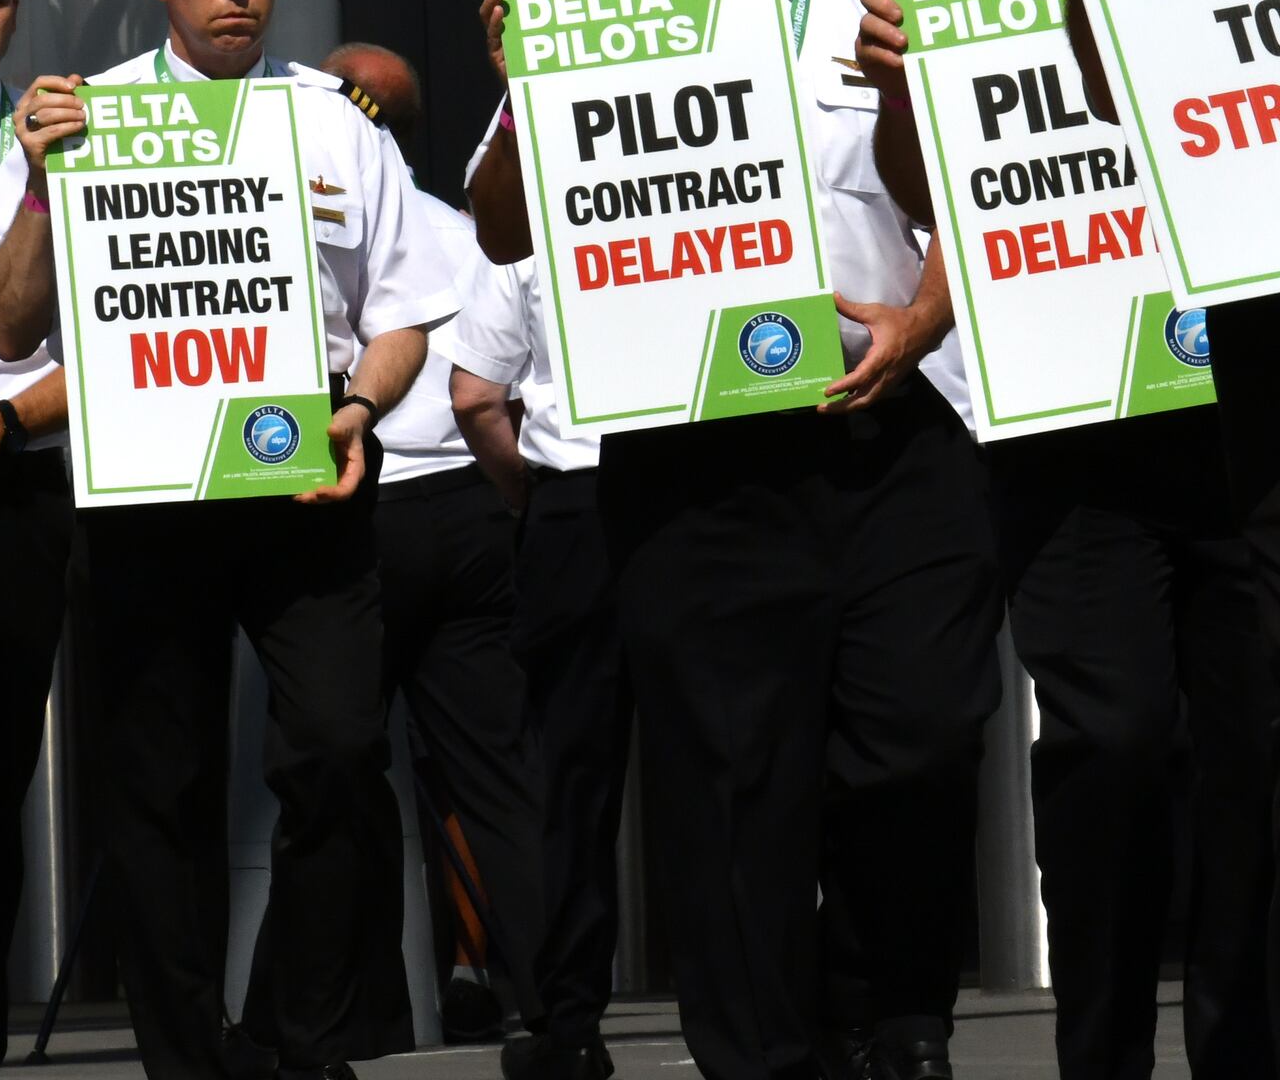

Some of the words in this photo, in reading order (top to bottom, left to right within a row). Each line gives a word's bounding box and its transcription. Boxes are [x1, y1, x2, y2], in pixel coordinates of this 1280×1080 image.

[523, 15, 699, 71] PILOTS
[83, 93, 198, 129] ELTA
[572, 79, 753, 161] PILOT
[973, 64, 1088, 142] PIL
[63, 129, 220, 169] PILOTS
[84, 177, 283, 221] INDUSTRY-
[566, 160, 784, 225] CONTRACT
[109, 227, 270, 270] LEADING
[575, 220, 792, 290] DELAYED
[984, 207, 1145, 280] DELAY
[95, 276, 292, 321] CONTRACT
[750, 314, 783, 327] DELTA
[131, 327, 267, 388] NOW
[742, 349, 758, 371] MASTER
[758, 364, 788, 374] EXECUTIVE
[787, 343, 800, 366] COUNCIL
[770, 346, 787, 356] alpa
[1169, 338, 1186, 359] MASTER
[1187, 356, 1210, 364] EXECUT
[254, 407, 284, 418] DELTA
